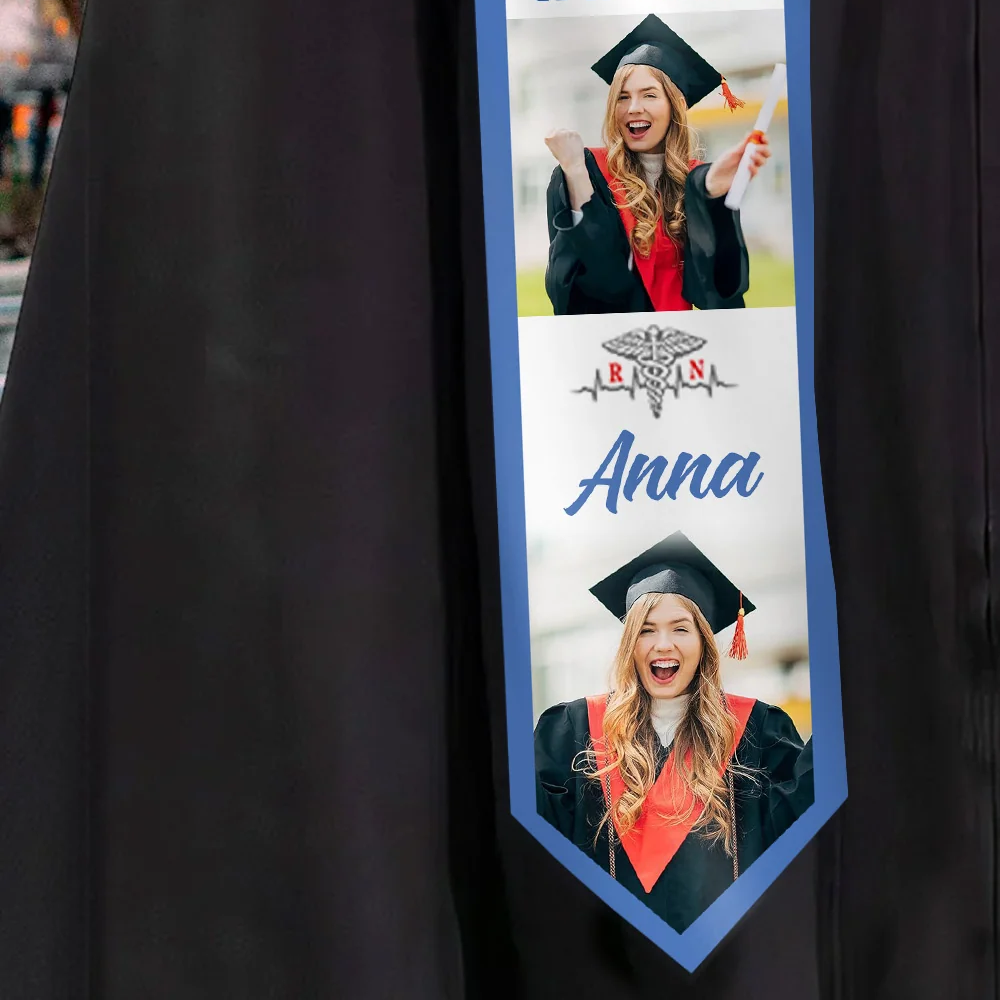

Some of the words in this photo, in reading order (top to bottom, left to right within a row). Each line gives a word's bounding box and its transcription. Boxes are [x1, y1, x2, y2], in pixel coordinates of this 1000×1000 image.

[608, 362, 624, 383] R
[689, 359, 705, 380] N
[563, 429, 765, 517] Anna
